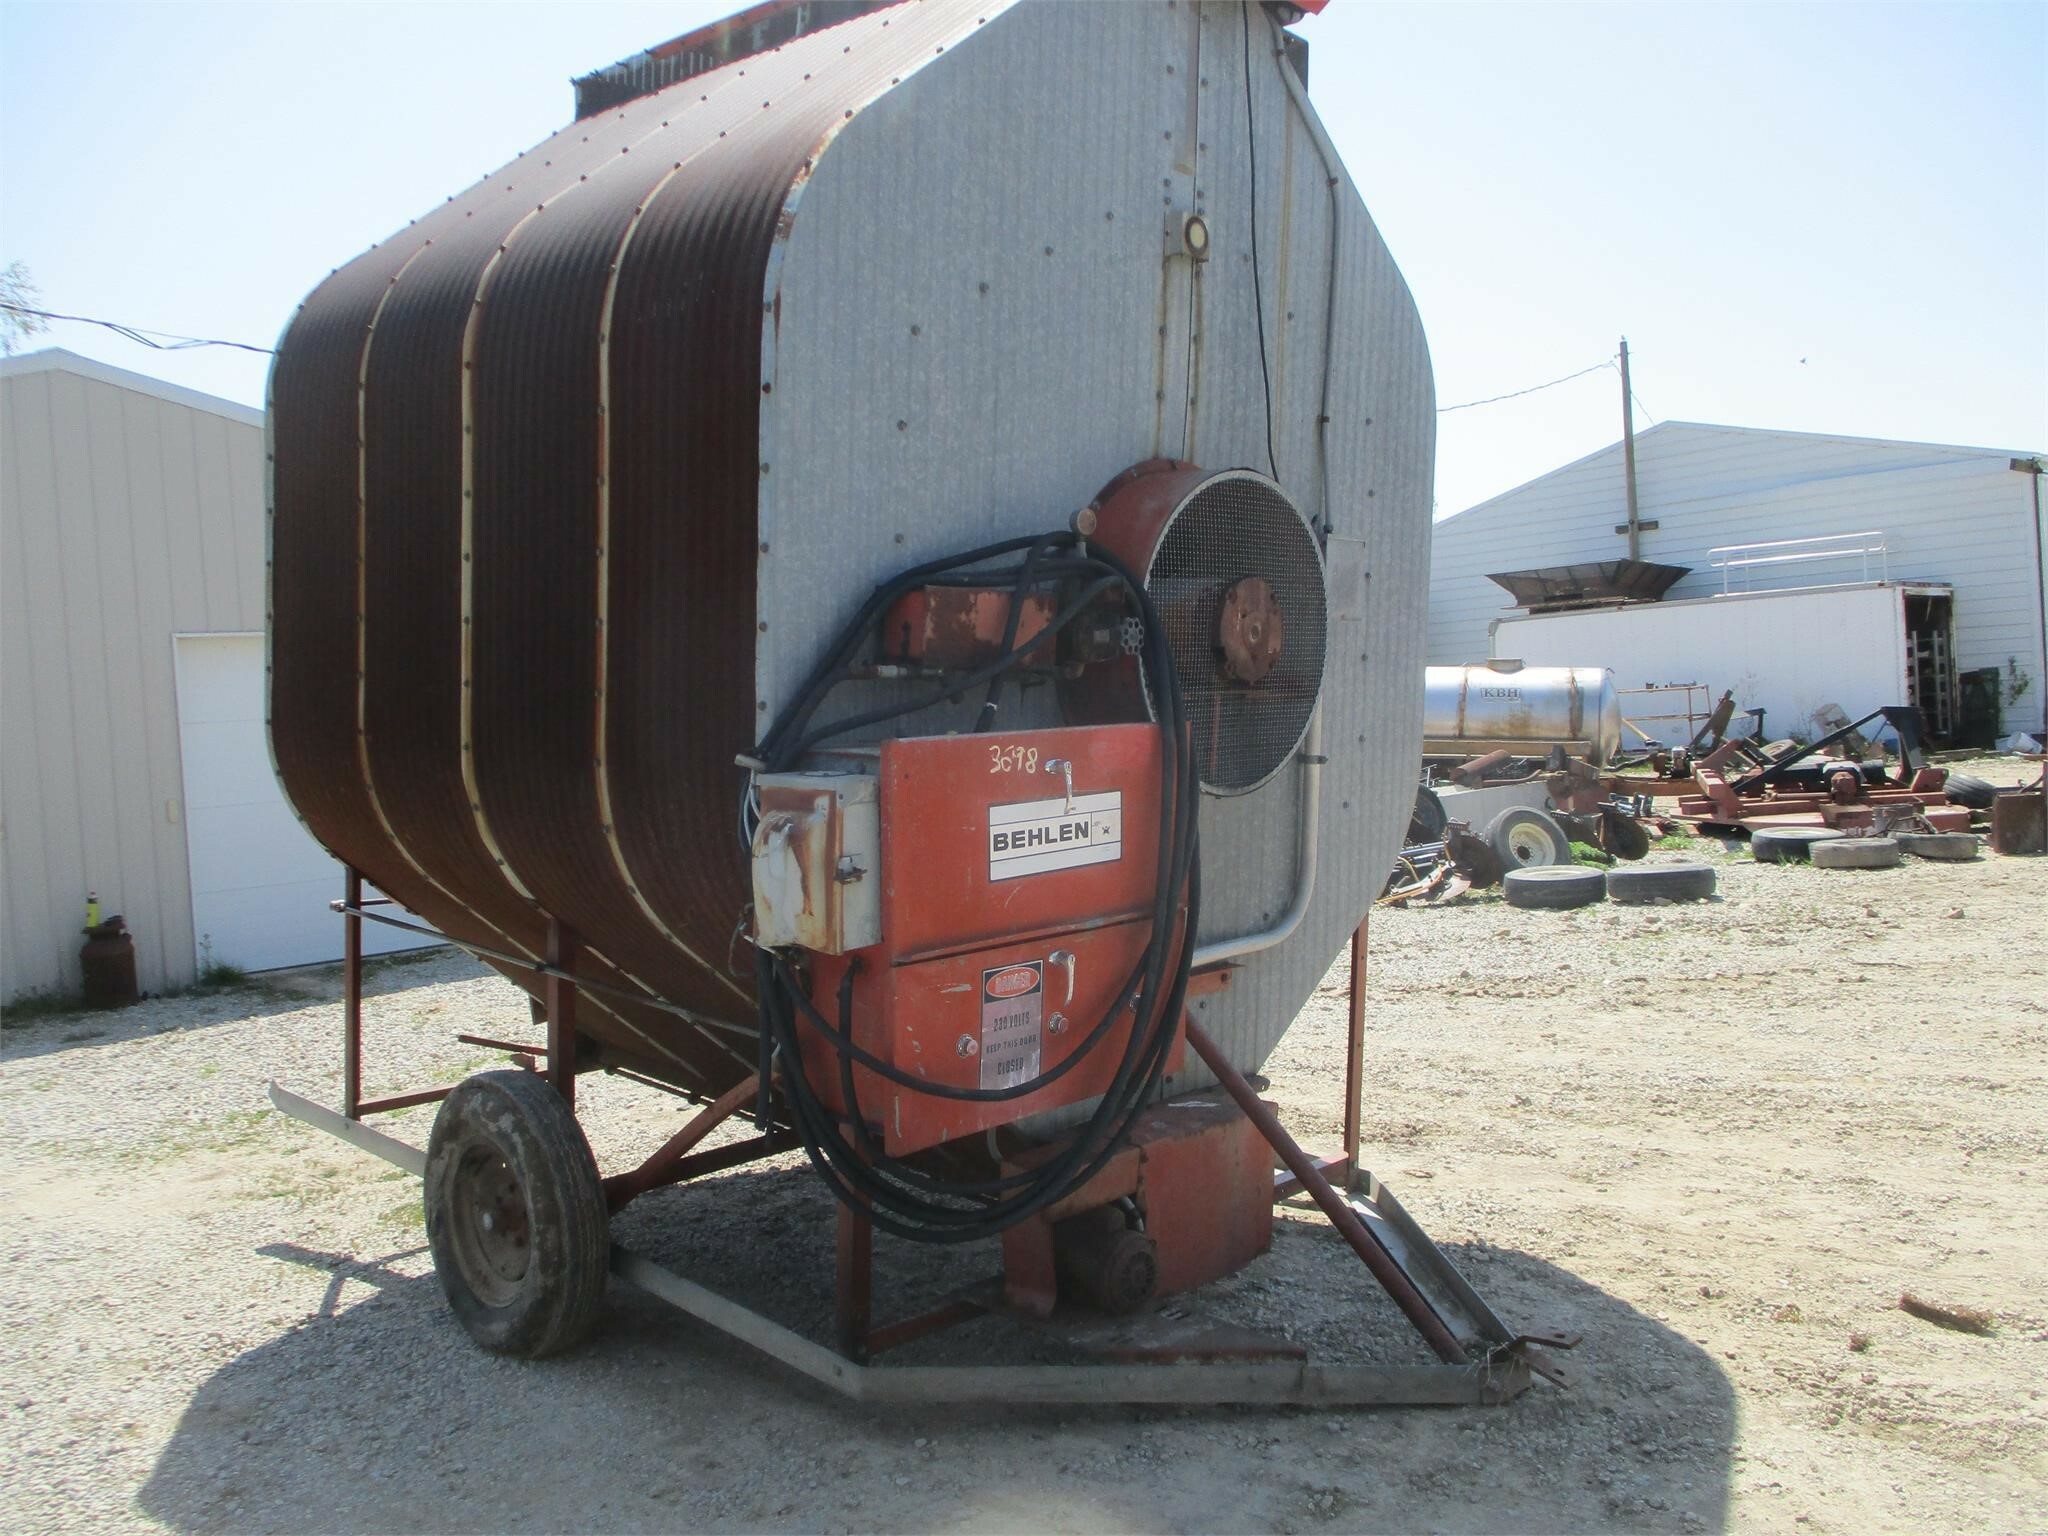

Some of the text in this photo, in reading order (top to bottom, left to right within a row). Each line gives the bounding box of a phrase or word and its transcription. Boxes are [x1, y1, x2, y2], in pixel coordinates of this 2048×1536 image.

[1484, 688, 1518, 698] KBH
[993, 821, 1089, 852] BEHLEN
[1009, 1011, 1030, 1028] VOLTS
[997, 1056, 1024, 1075] CLOSED
